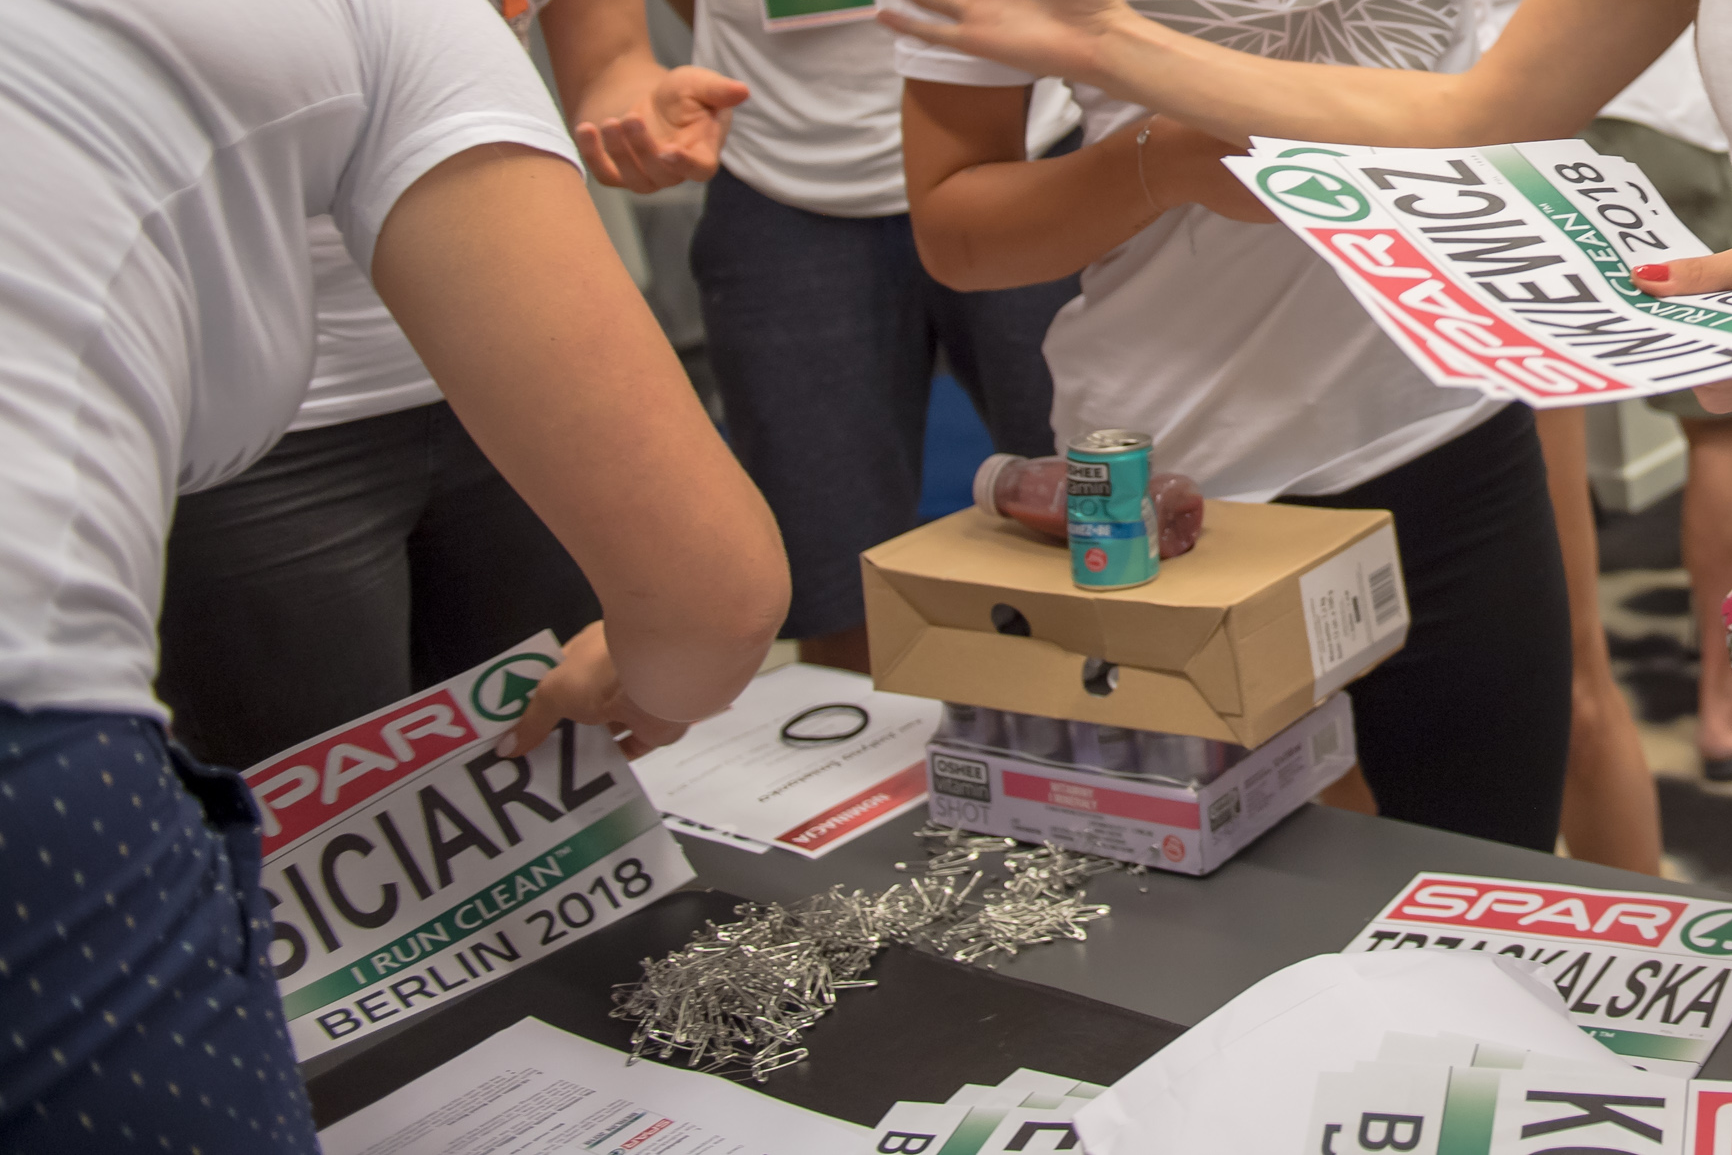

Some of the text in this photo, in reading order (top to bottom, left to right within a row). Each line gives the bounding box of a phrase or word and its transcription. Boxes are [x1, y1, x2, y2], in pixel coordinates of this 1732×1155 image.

[1553, 160, 1671, 253] 2018
[1329, 234, 1608, 394] SPAR
[1635, 302, 1718, 326] RUN
[259, 702, 468, 838] PAR
[938, 759, 983, 780] OSHEE
[937, 799, 991, 825] SHOT
[1402, 884, 1672, 940] SPAR
[315, 857, 654, 1040] BERLIN 2018
[370, 922, 451, 976] RUN
